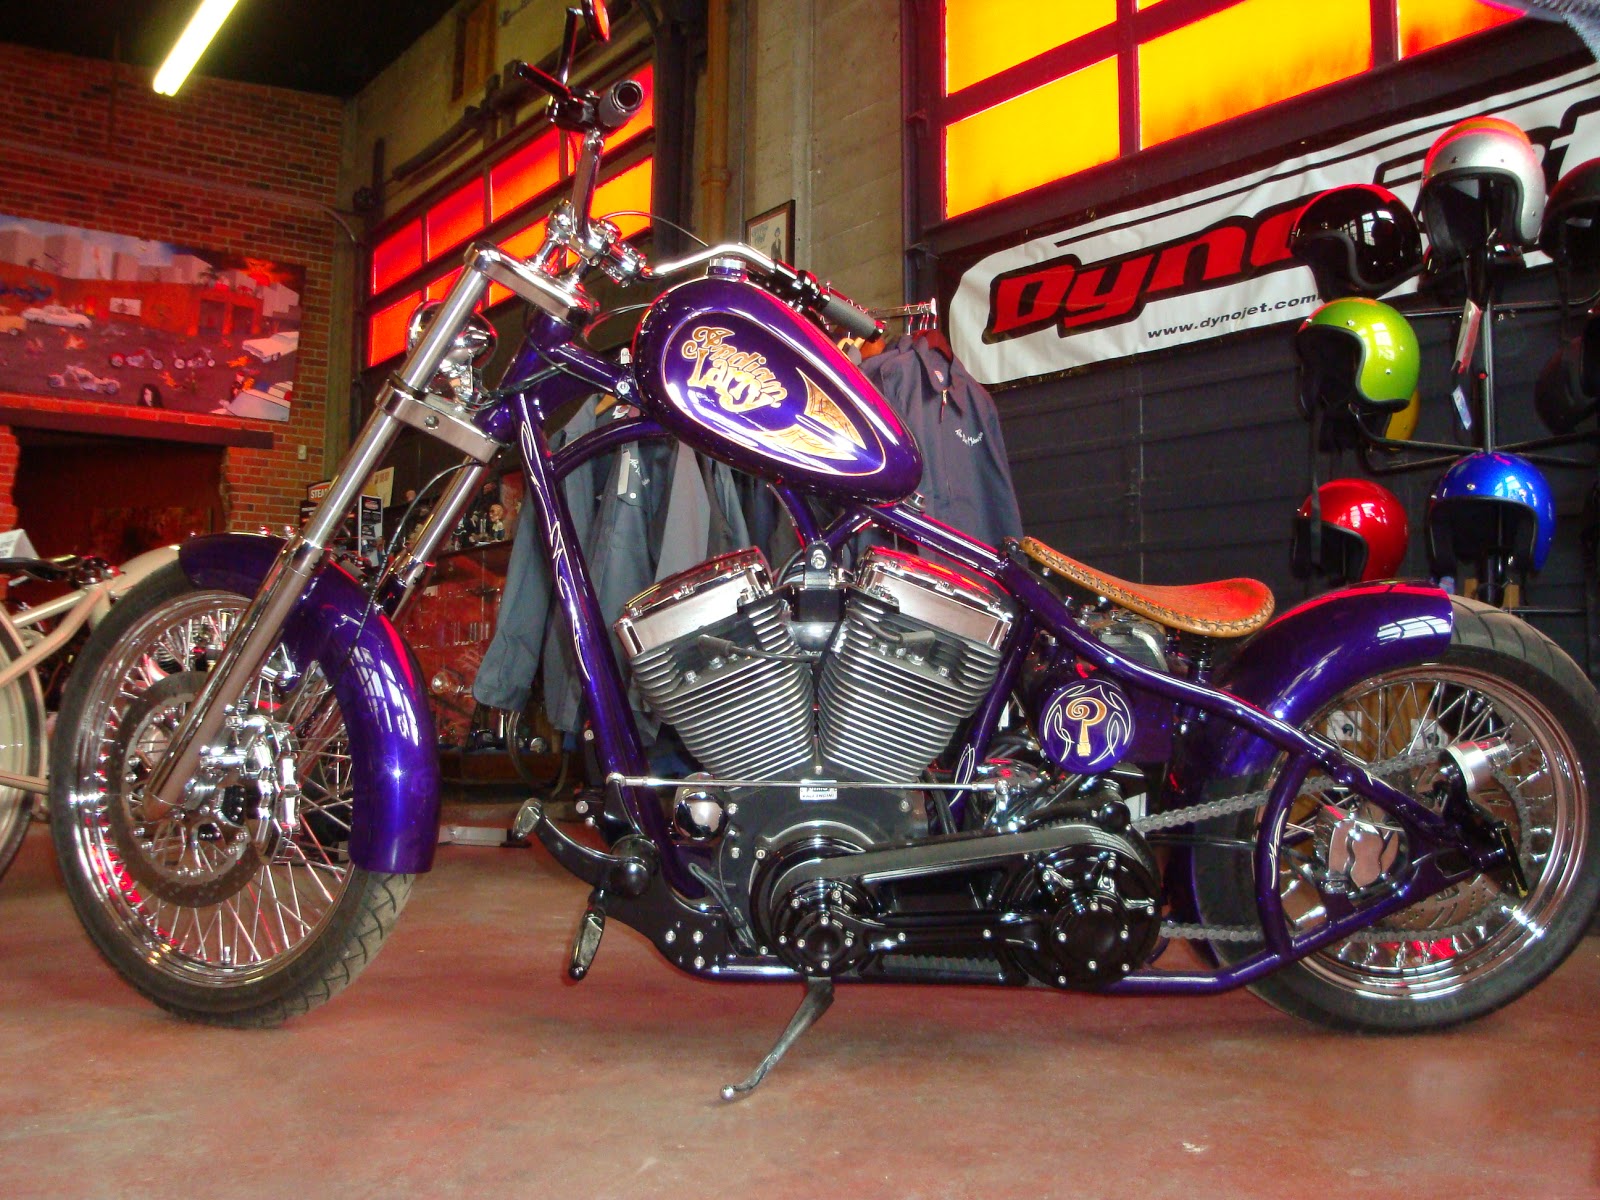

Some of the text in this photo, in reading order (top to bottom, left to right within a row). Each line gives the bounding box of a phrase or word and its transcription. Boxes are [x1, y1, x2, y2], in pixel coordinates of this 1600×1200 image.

[1147, 293, 1319, 339] www.dynojet.com
[682, 340, 776, 414] Larry
[690, 325, 788, 409] Indian
